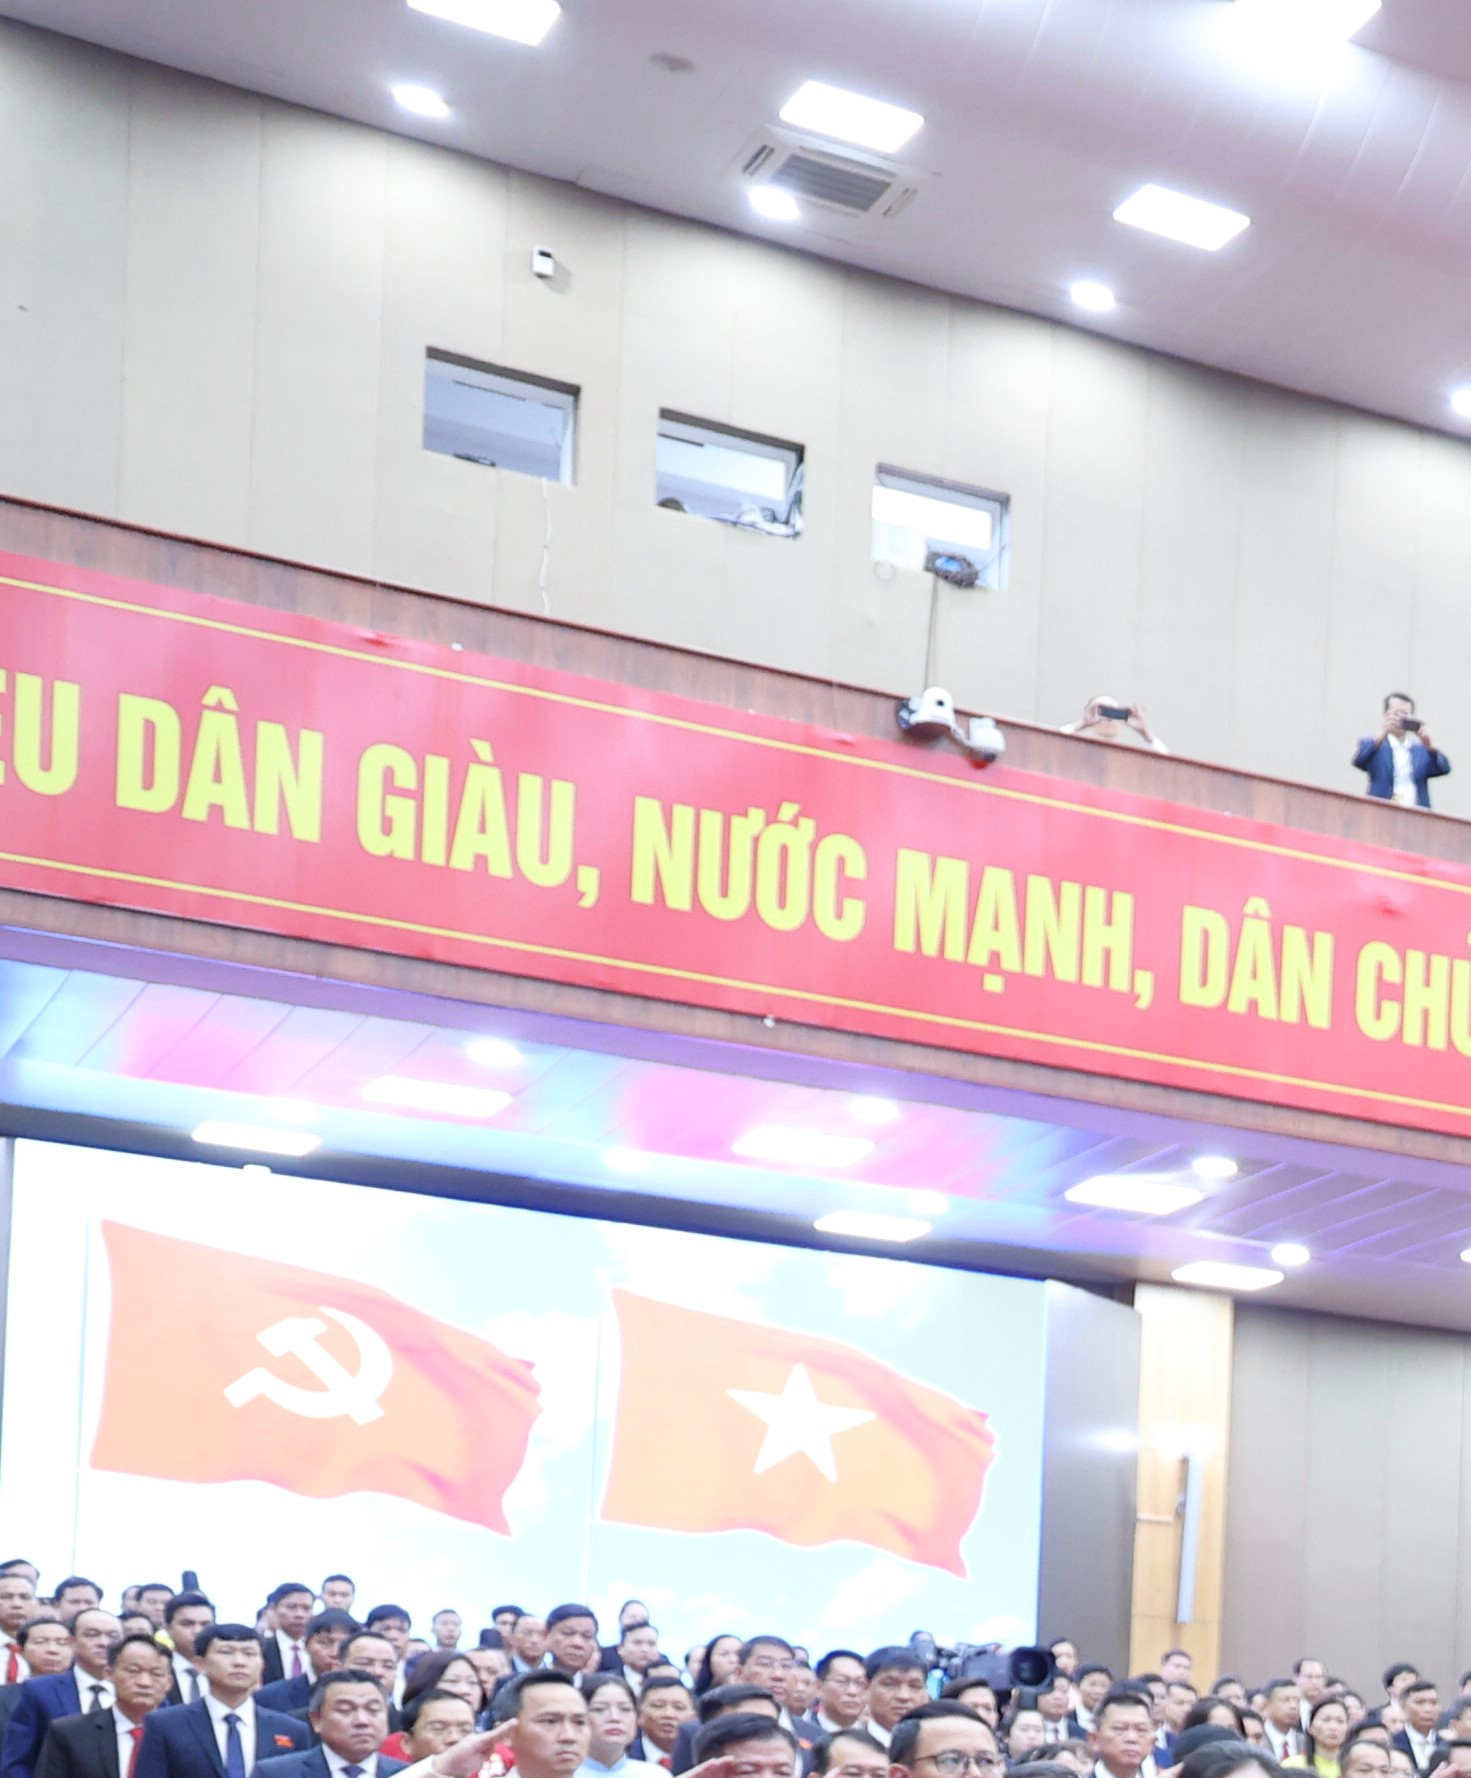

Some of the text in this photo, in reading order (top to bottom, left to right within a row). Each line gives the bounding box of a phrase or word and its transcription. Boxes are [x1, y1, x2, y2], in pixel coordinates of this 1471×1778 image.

[116, 685, 324, 844] DÂN
[356, 738, 600, 909] GIÀU,
[631, 795, 867, 942] NƯỚC
[894, 847, 1155, 1011] MẠNH,
[1180, 897, 1335, 1030] DÂN
